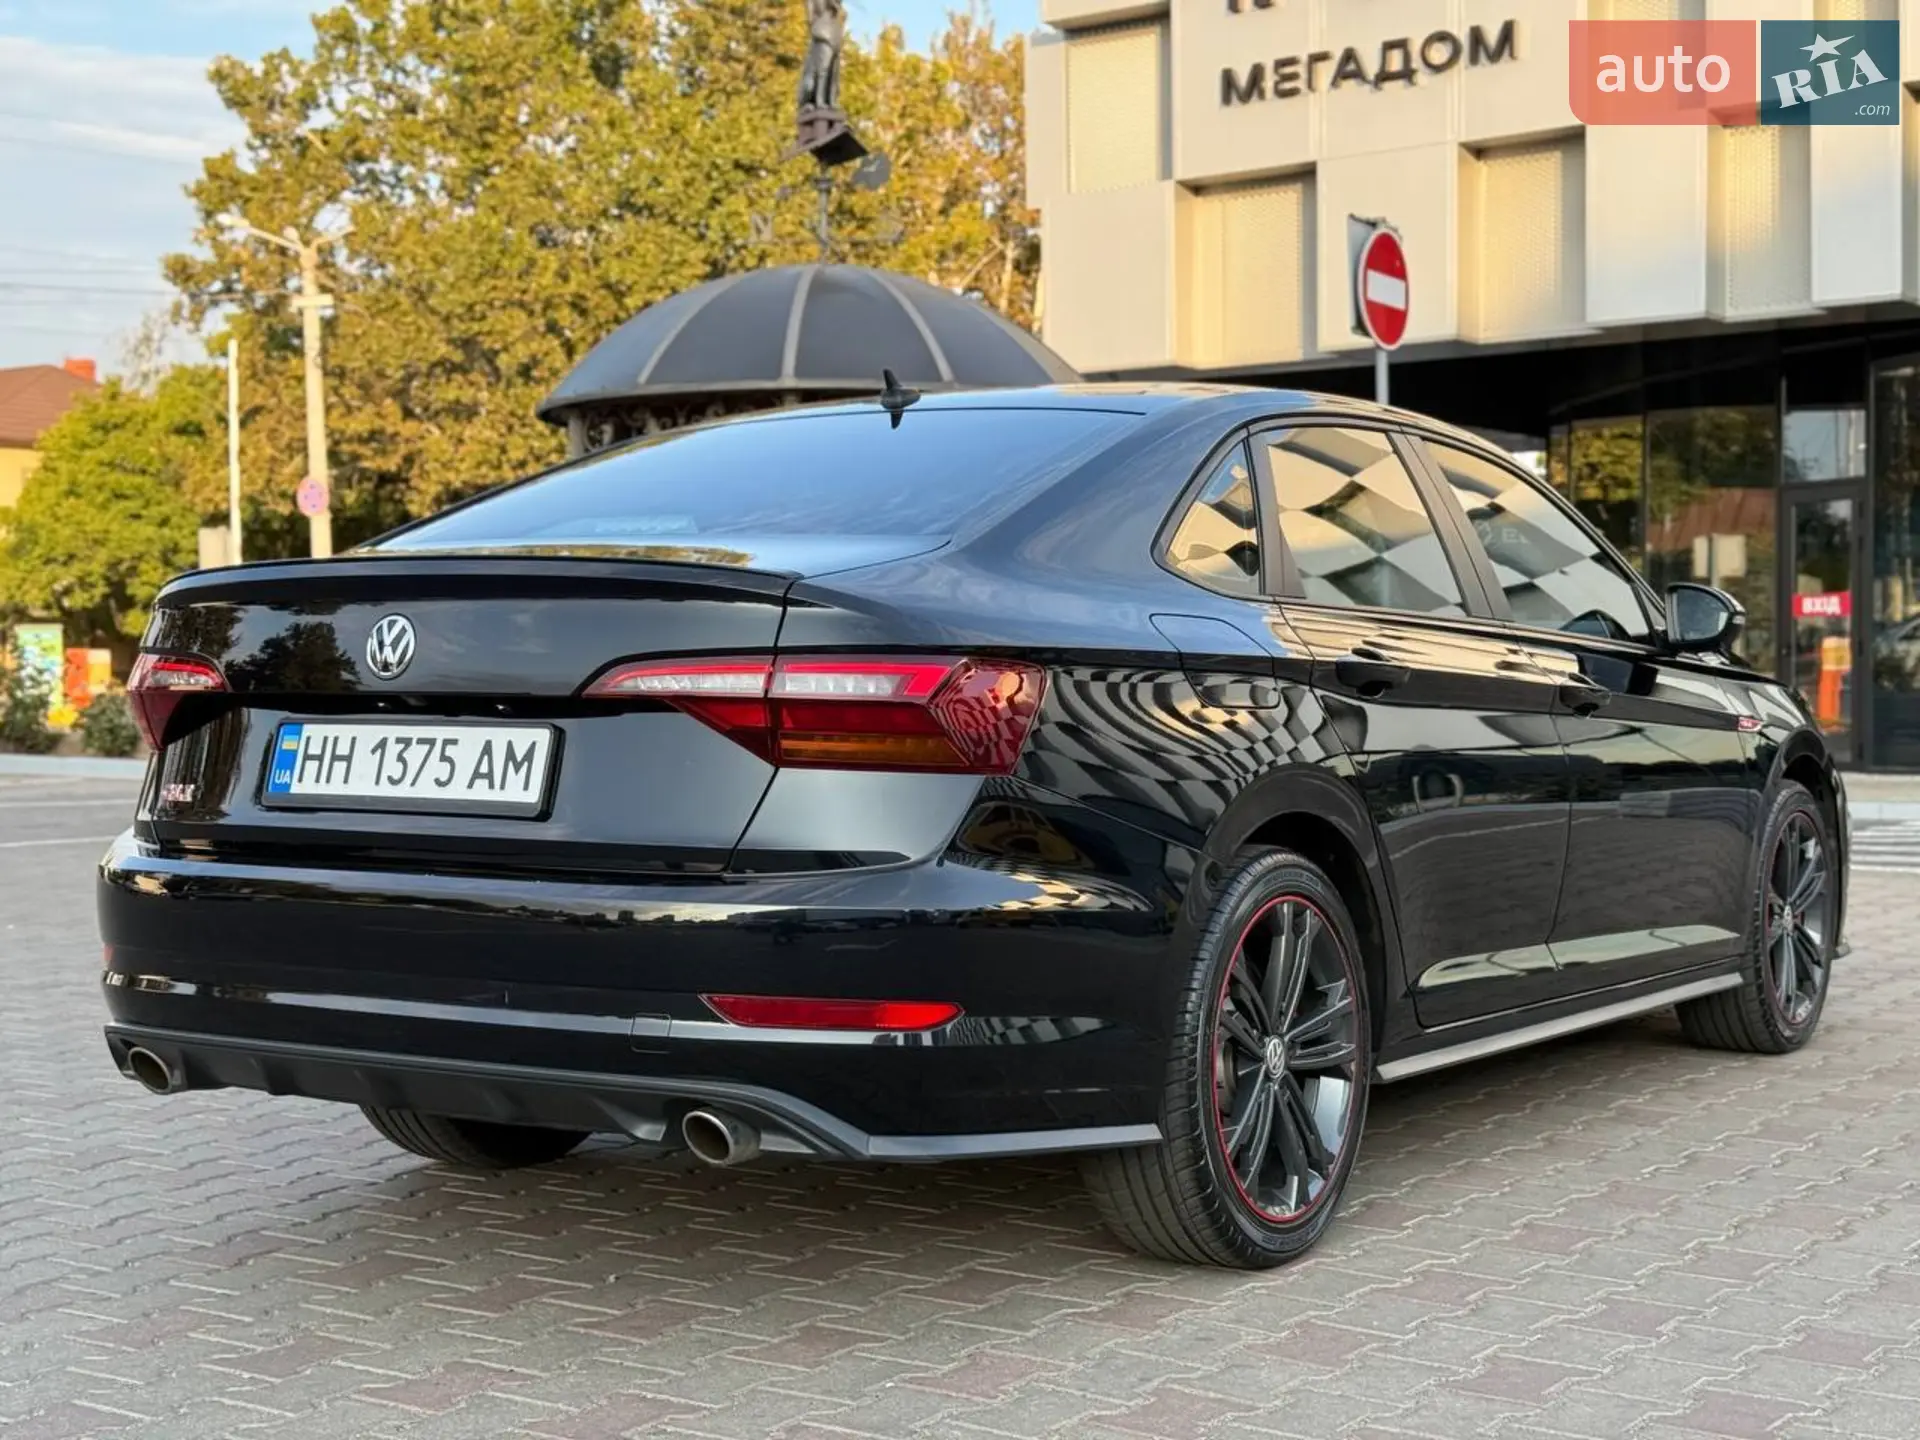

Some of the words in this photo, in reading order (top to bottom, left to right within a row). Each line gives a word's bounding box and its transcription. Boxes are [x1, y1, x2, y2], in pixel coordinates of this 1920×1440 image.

[1220, 19, 1518, 105] МЕГАДОМ
[274, 773, 291, 784] UA
[297, 735, 357, 784] HH
[370, 736, 459, 787] 1375
[467, 739, 537, 791] AM
